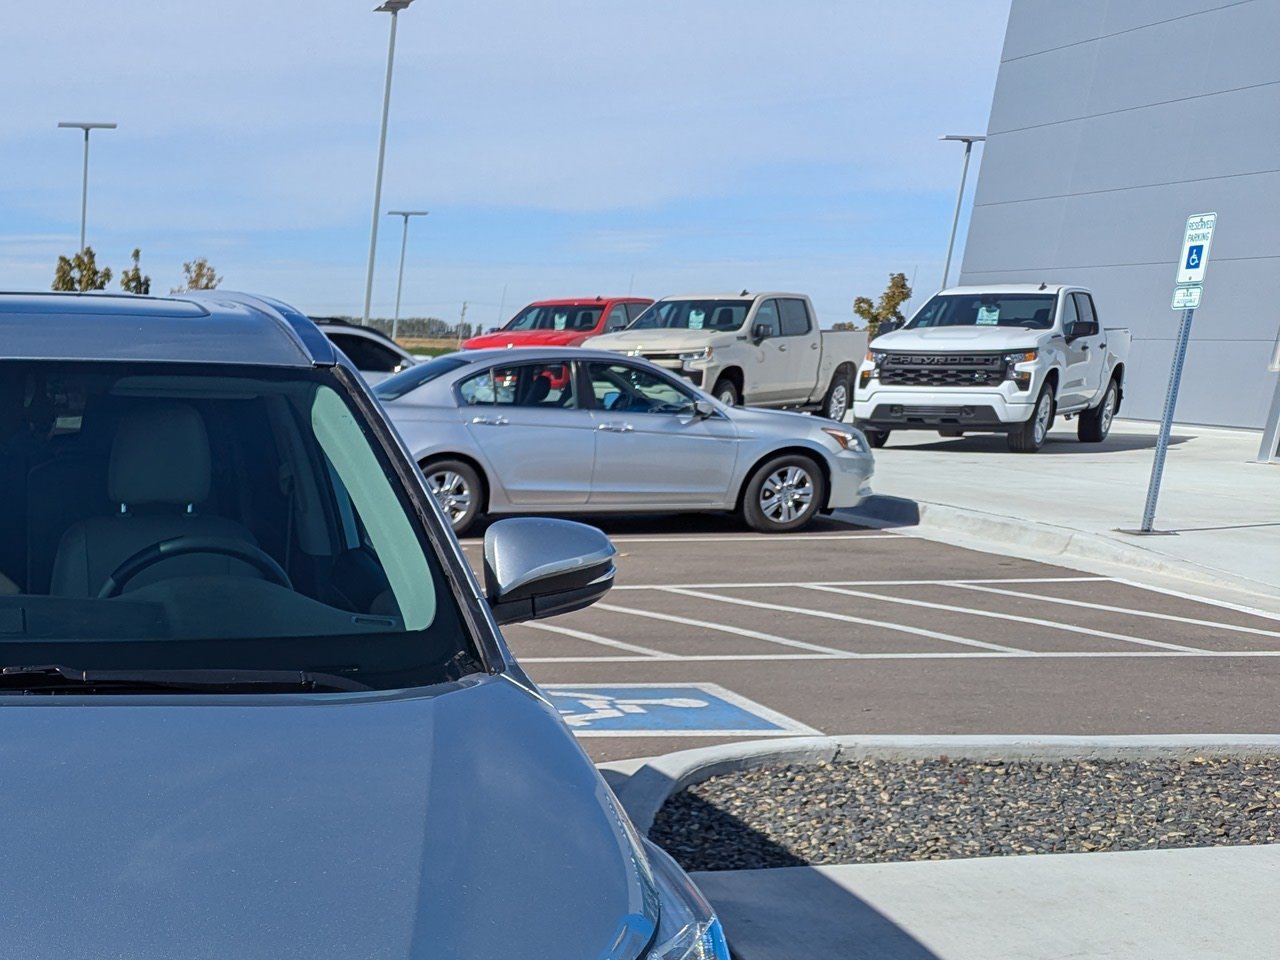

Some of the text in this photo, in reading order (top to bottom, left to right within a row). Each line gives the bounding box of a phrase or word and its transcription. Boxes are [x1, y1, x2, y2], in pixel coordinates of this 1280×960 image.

[1188, 220, 1213, 230] RESERVED
[1187, 232, 1209, 242] PARKING
[887, 355, 1000, 366] CHEVROLET
